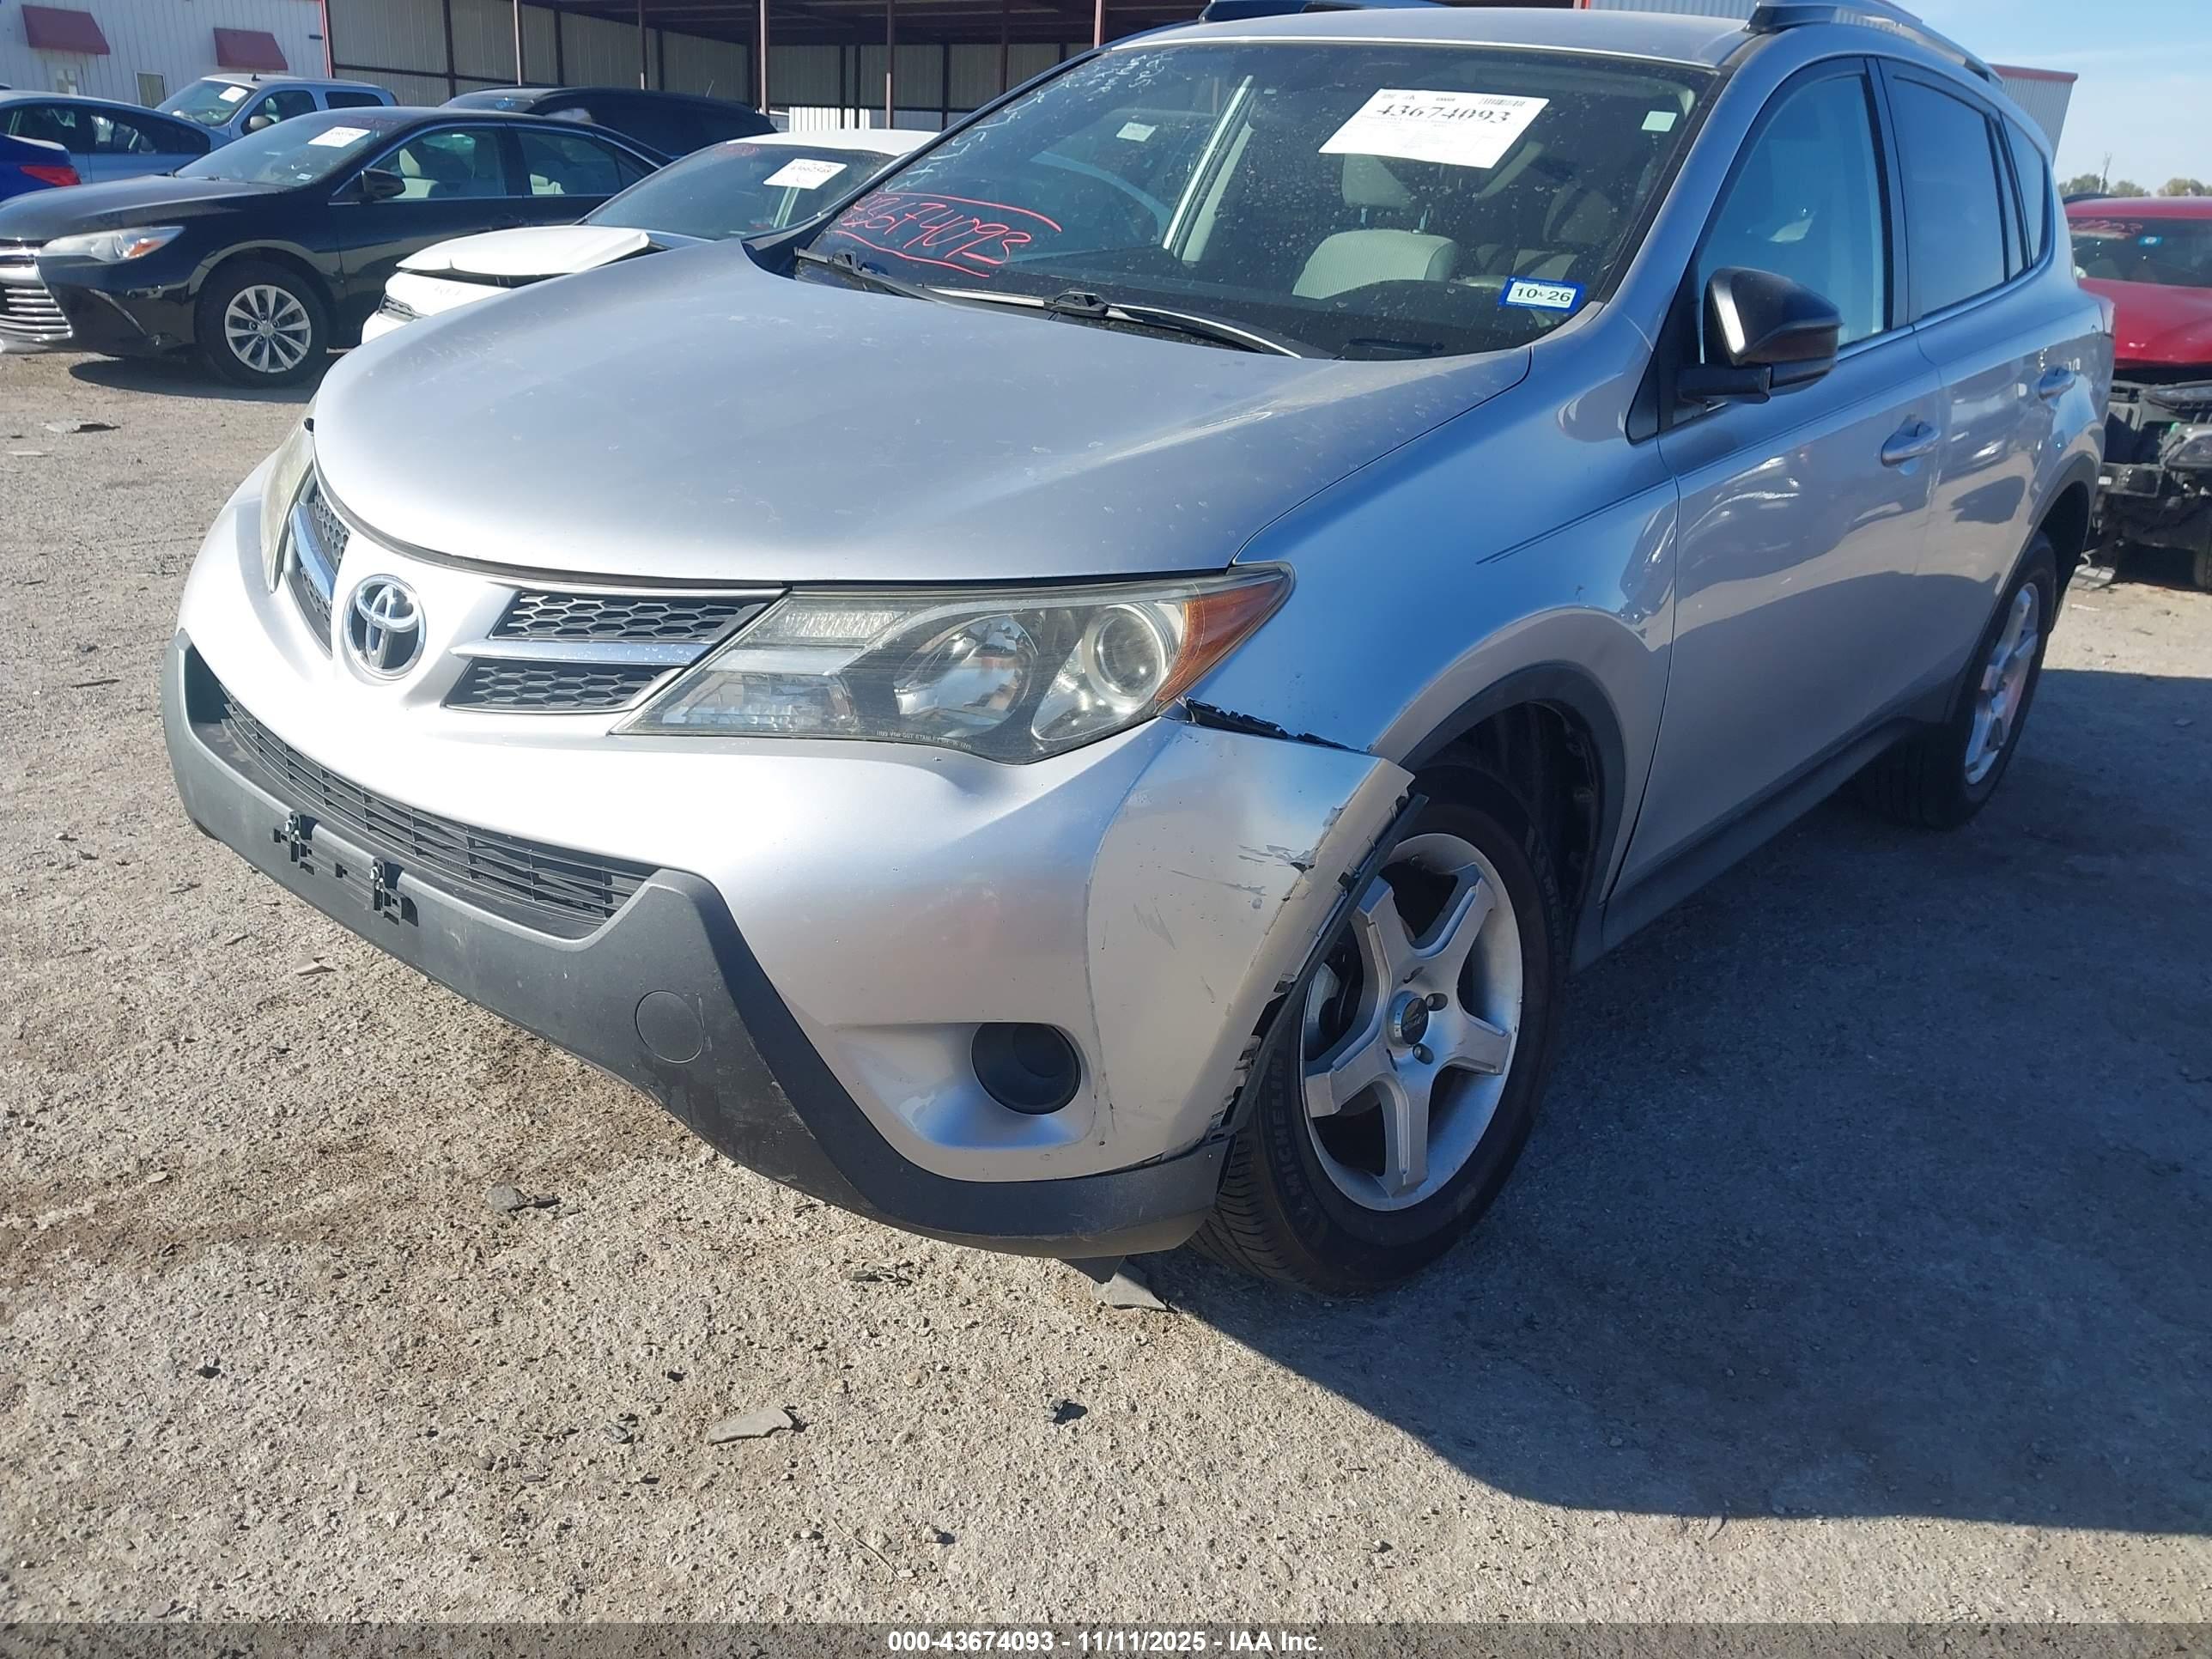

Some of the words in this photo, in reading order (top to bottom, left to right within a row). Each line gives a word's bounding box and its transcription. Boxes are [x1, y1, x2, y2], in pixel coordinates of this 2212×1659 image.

[1376, 103, 1511, 124] 43674093
[1516, 288, 1538, 299] 10
[1547, 290, 1572, 302] 26
